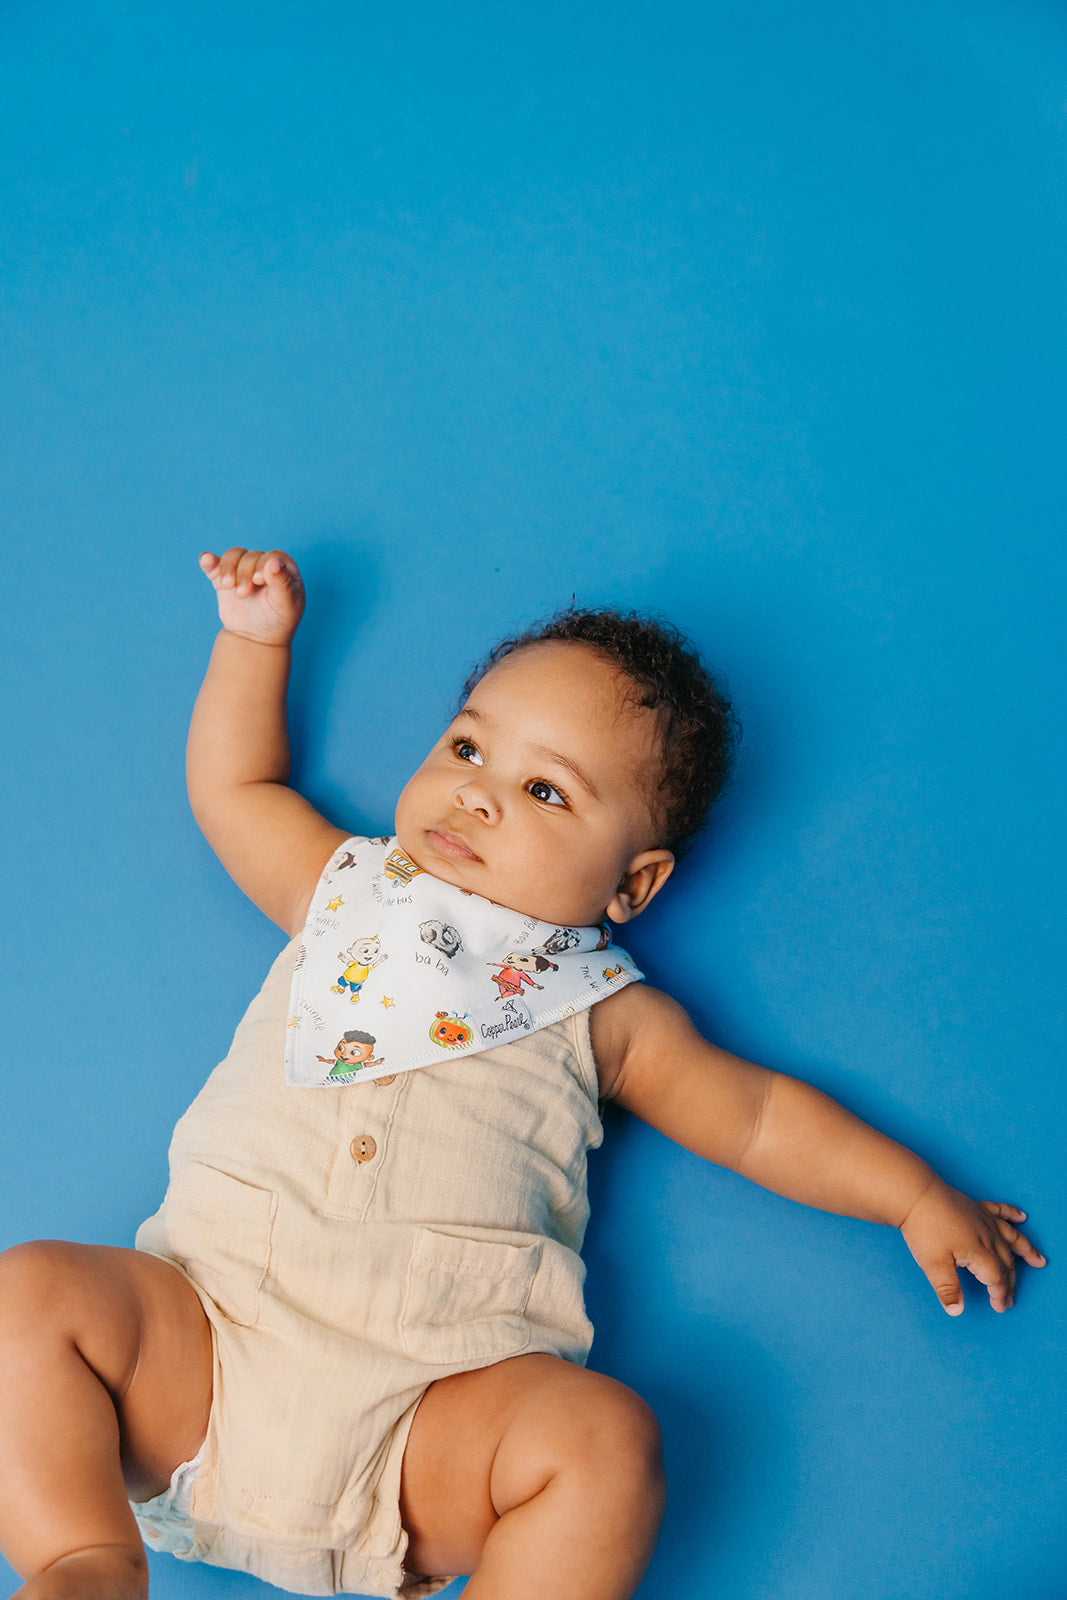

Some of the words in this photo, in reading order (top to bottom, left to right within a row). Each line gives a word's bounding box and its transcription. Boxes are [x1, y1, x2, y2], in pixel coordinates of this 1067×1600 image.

[397, 895, 412, 905] bus
[415, 951, 431, 966] ba
[435, 958, 450, 976] ba
